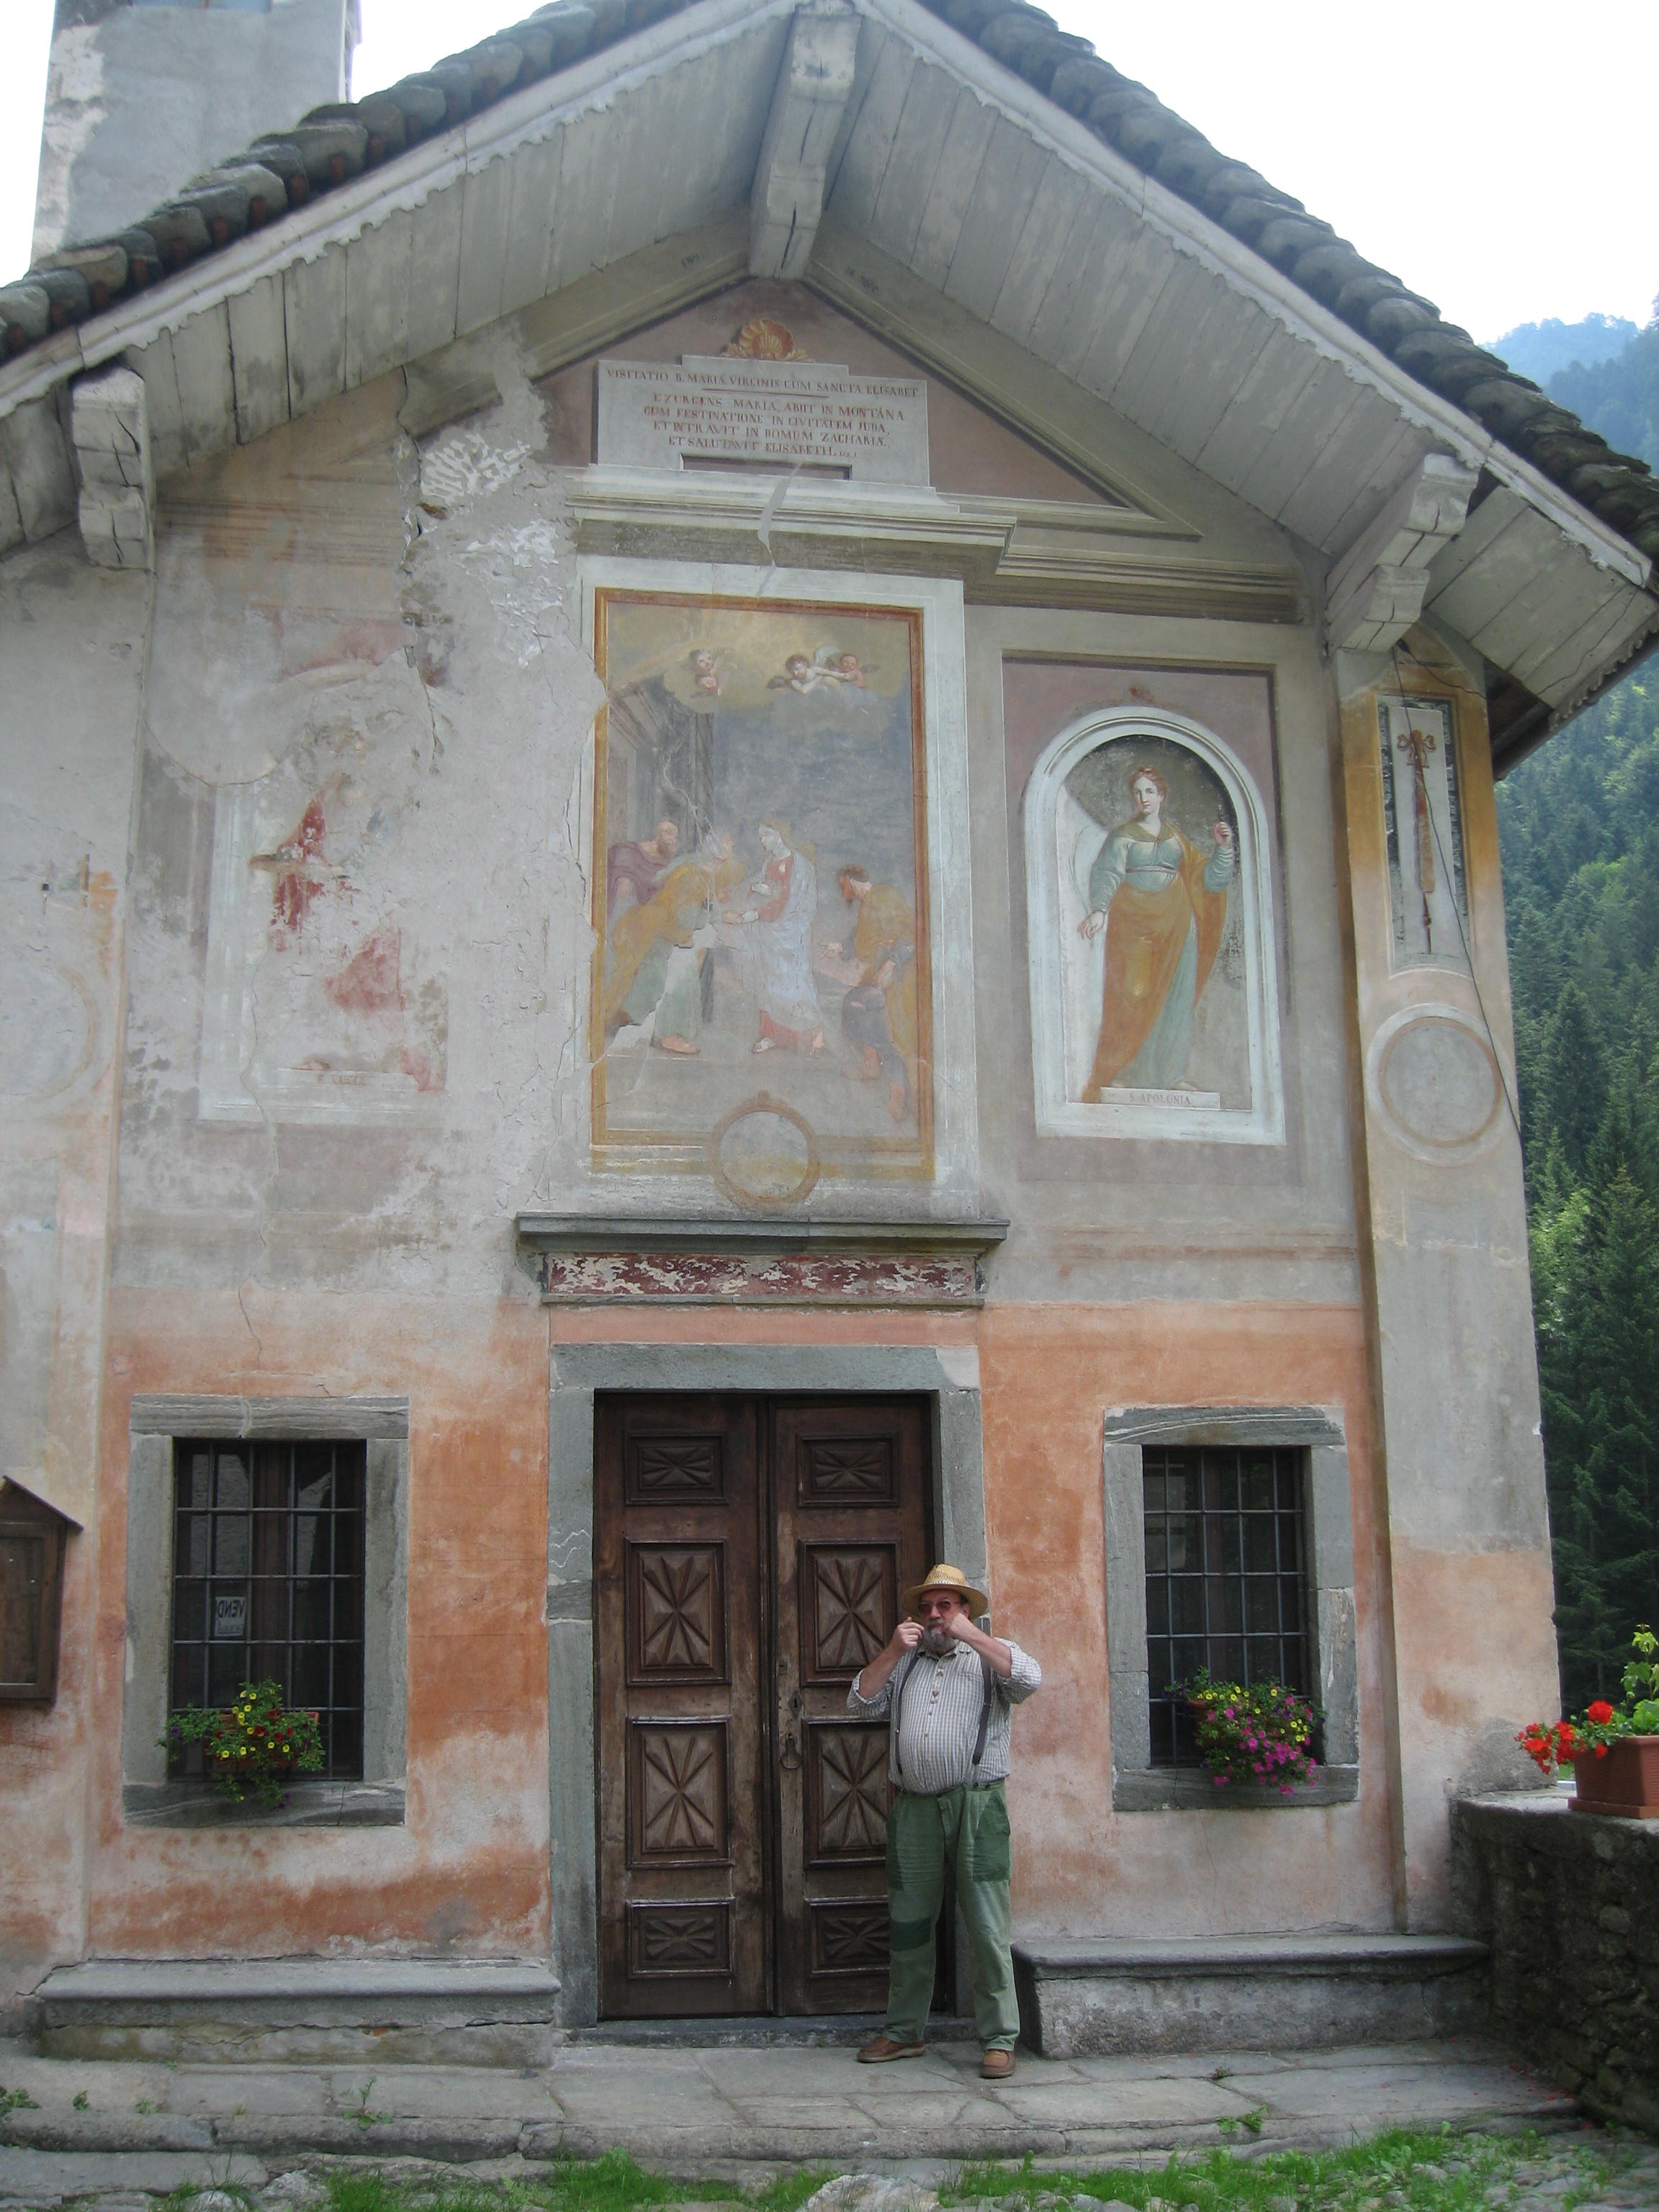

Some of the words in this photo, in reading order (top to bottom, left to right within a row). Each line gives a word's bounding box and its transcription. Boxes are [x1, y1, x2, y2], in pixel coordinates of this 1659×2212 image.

[606, 368, 669, 381] VISITATIO
[783, 379, 811, 390] CUM
[816, 382, 861, 394] SANCTA
[644, 405, 670, 417] CUM
[676, 408, 763, 424] FESTINATIONE
[771, 415, 784, 426] IN
[821, 404, 833, 415] IN
[653, 420, 670, 431] ET
[673, 421, 741, 436] INTRAVIT
[745, 426, 759, 437] IN
[765, 428, 813, 441] DOMUM
[668, 435, 686, 446] ET
[688, 436, 760, 451] SALUTAVIT
[1141, 1093, 1190, 1105] APOLONIA
